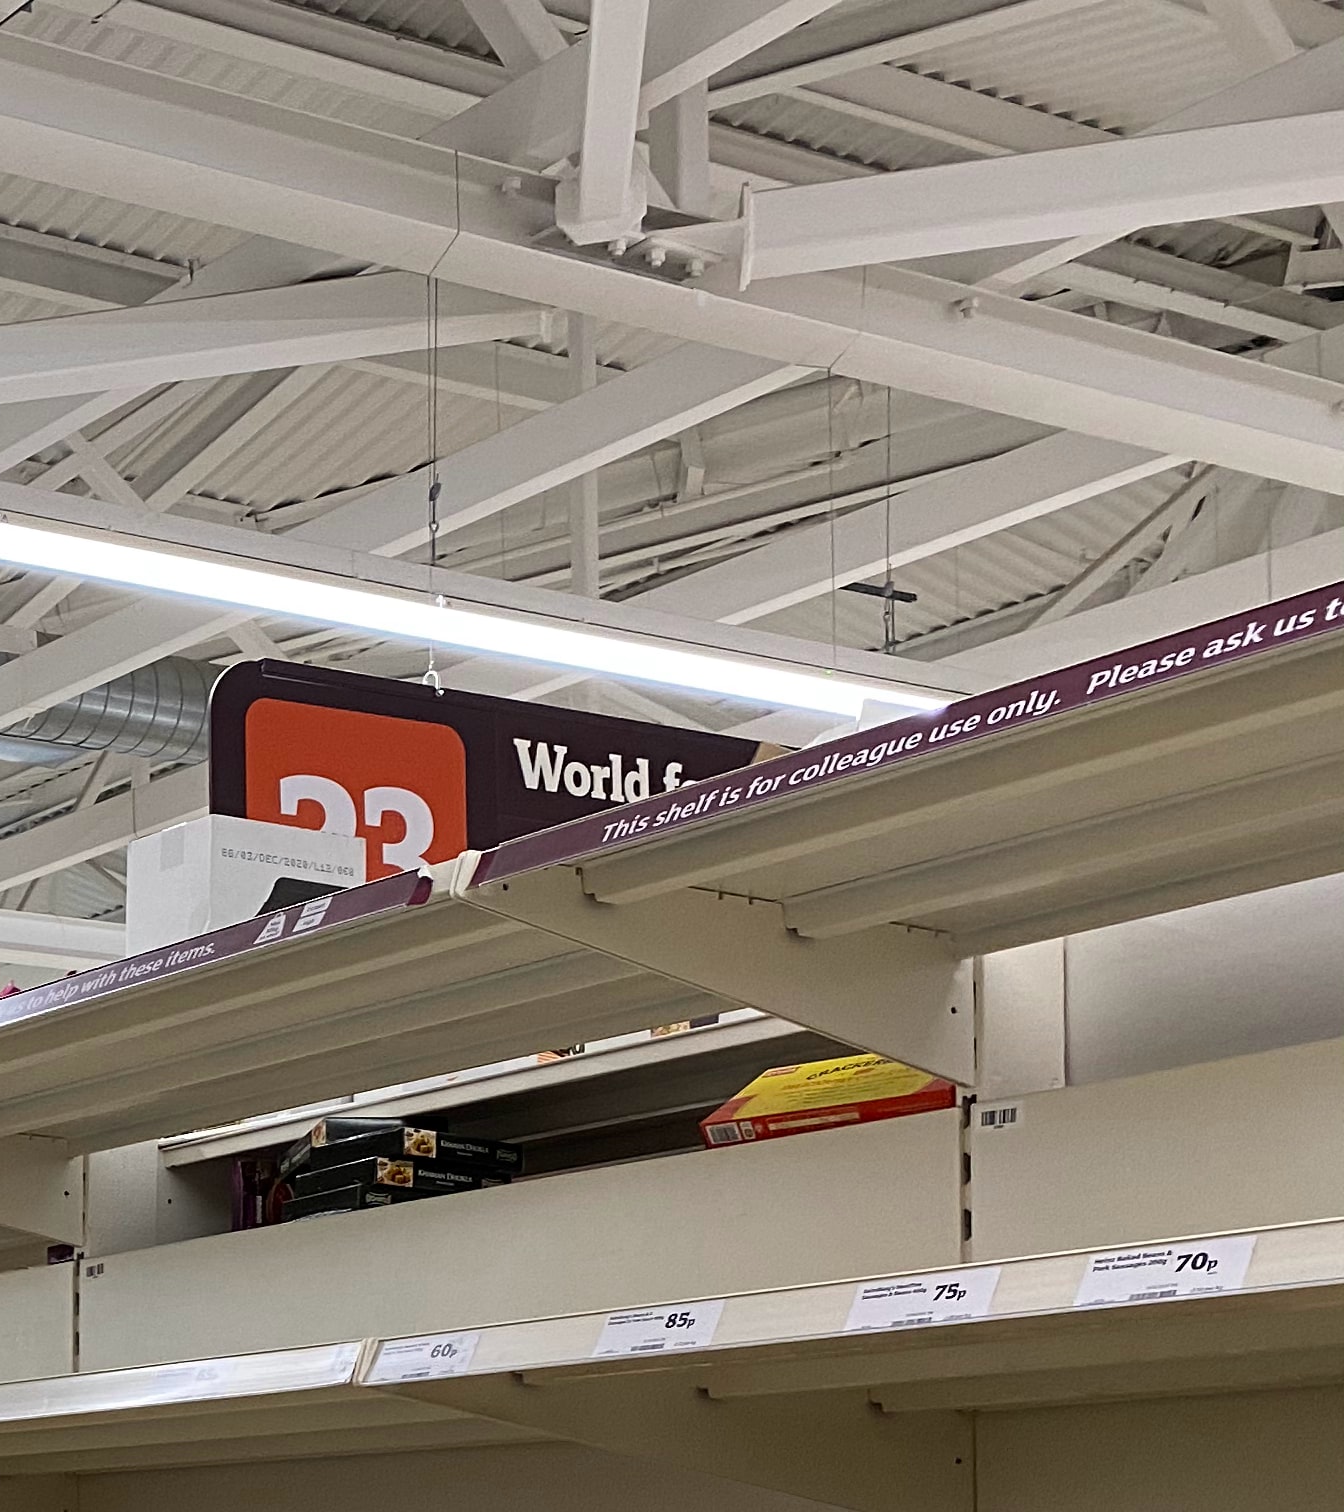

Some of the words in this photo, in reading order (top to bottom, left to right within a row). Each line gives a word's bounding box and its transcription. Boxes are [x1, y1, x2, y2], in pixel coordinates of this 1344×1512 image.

[602, 814, 651, 843] This
[652, 790, 720, 829] shelf
[718, 786, 743, 808] is
[745, 775, 786, 800] for
[788, 732, 924, 786] colleague
[927, 718, 983, 743] use
[987, 690, 1061, 726] only.
[1087, 643, 1196, 695] Please
[1203, 620, 1268, 659] ask
[1273, 608, 1317, 638] us
[514, 738, 652, 803] World
[663, 762, 700, 793] f
[280, 775, 435, 876] 23
[45, 982, 79, 1003] help
[80, 972, 116, 993] with
[118, 958, 163, 982] these
[164, 942, 216, 969] items.
[1175, 1252, 1218, 1273] 70p
[933, 1282, 967, 1302] 75p
[665, 1312, 696, 1329] 85p
[430, 1343, 458, 1359] 60p
